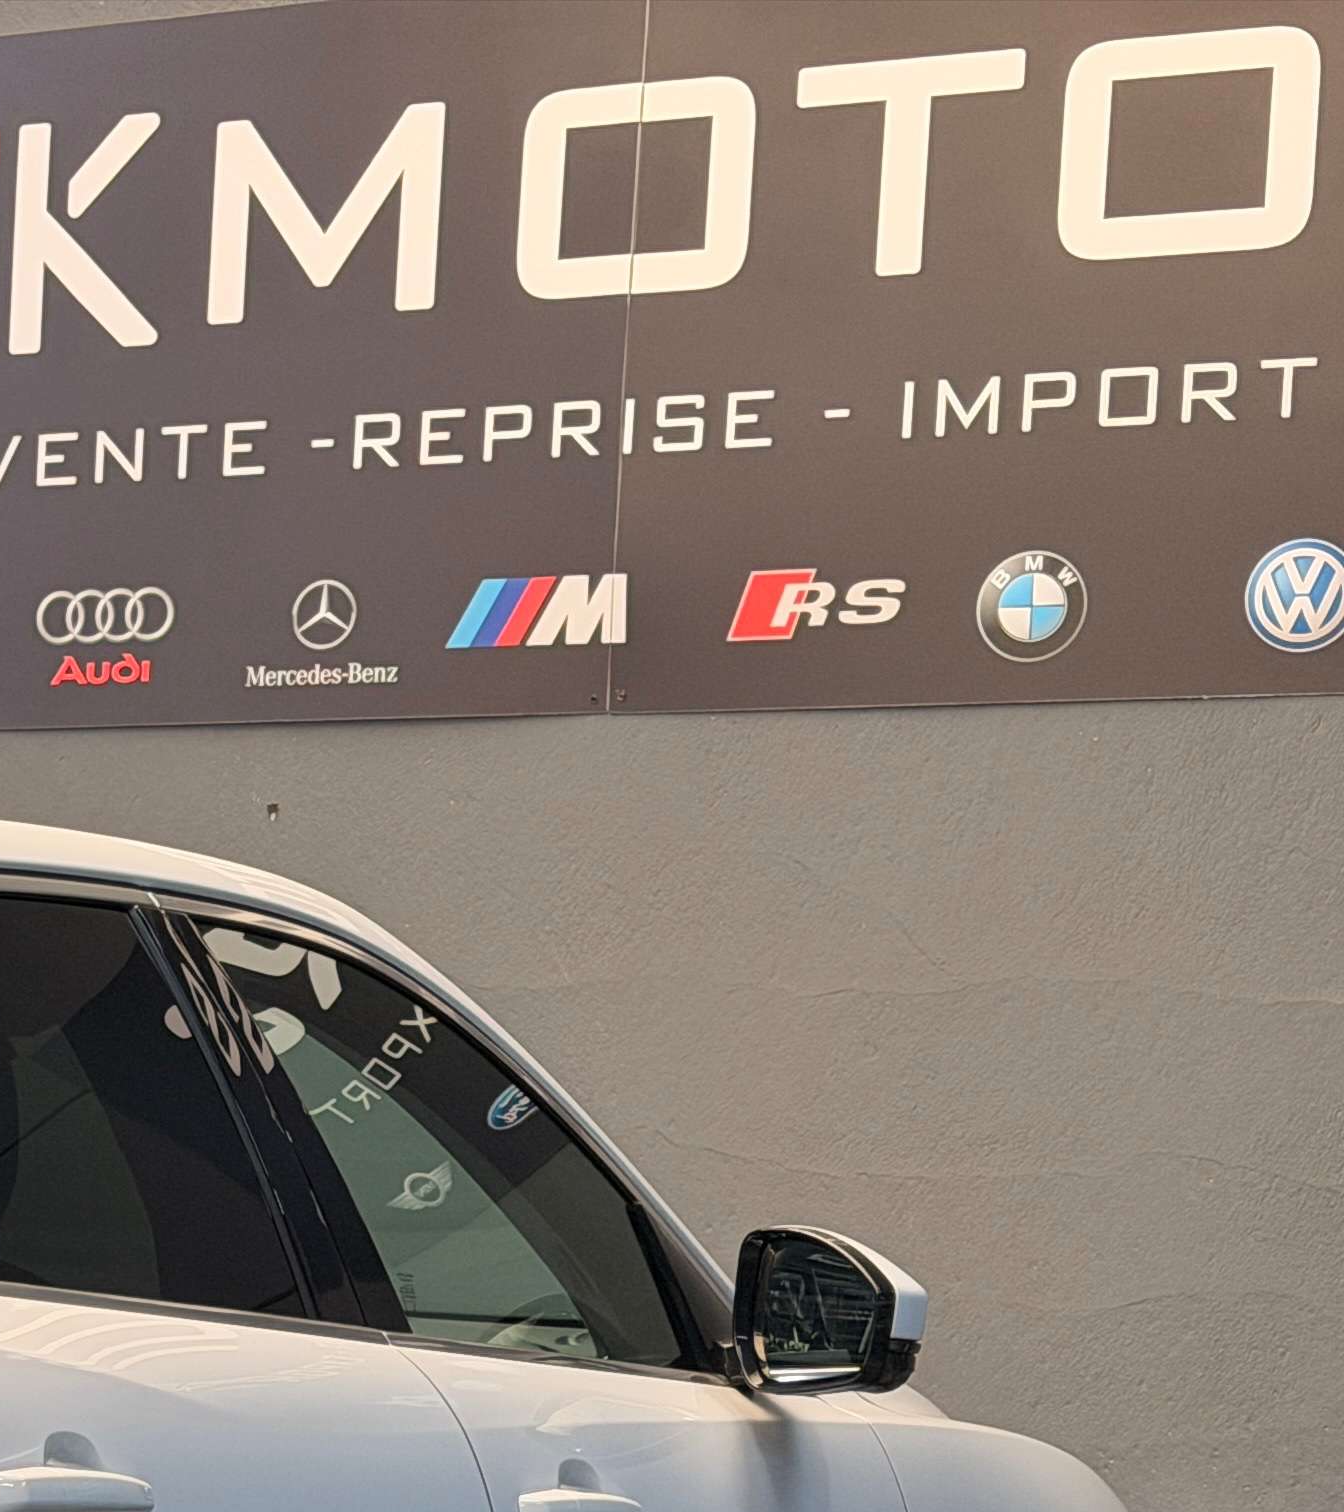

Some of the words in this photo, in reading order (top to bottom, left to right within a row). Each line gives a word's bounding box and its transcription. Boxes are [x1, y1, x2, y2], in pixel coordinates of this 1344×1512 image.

[901, 356, 1318, 439] IMPORT
[990, 555, 1078, 590] BMW
[768, 578, 906, 629] RS
[51, 653, 152, 688] Audi
[244, 661, 399, 689] Mercedes-Benz
